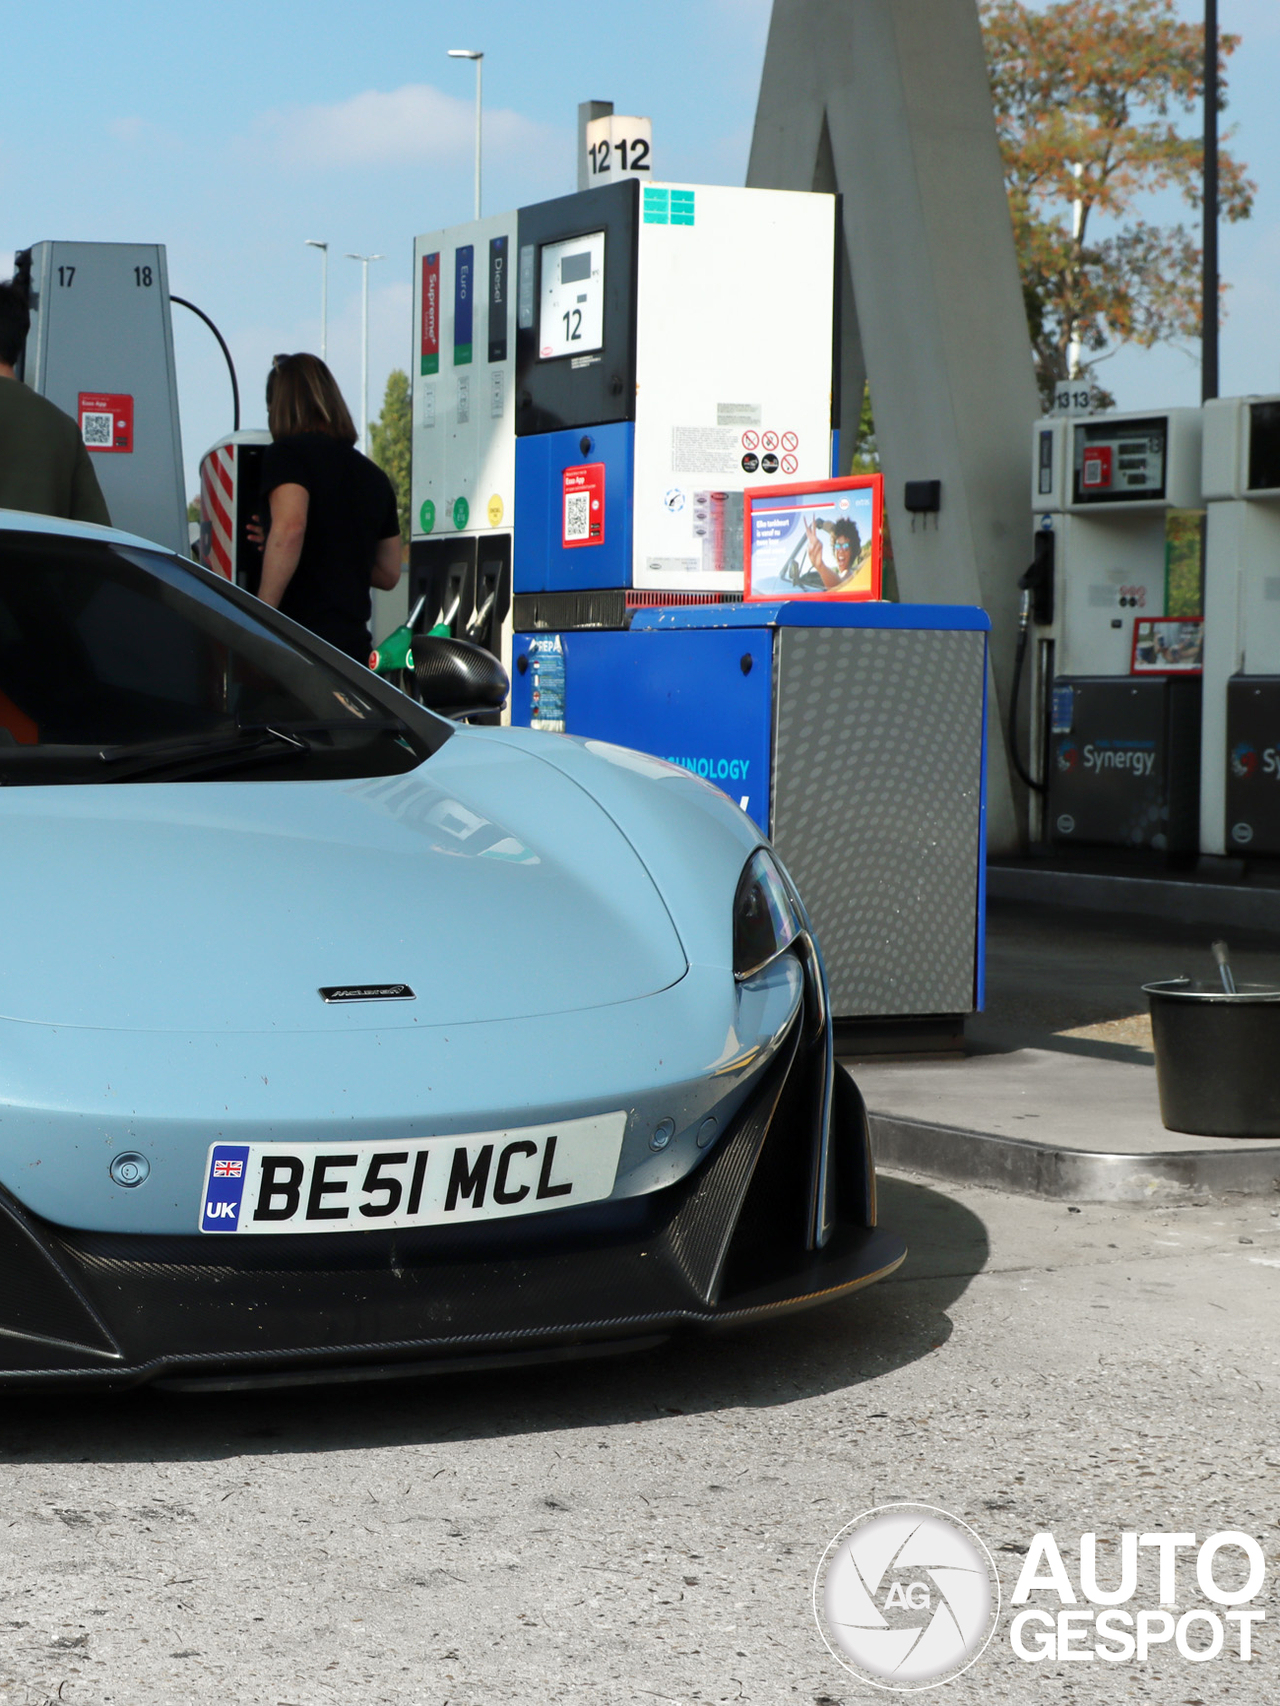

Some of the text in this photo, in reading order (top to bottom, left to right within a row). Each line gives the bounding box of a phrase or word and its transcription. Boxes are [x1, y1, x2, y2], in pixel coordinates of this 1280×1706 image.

[589, 140, 610, 174] 12
[614, 138, 650, 171] 12
[58, 266, 76, 287] 17
[134, 266, 153, 287] 18
[460, 265, 469, 300] Euro
[494, 257, 503, 303] Diesel
[562, 308, 582, 342] 12
[1072, 391, 1090, 408] 13
[1083, 744, 1155, 776] Synergy
[444, 1136, 573, 1211] MCL
[206, 1202, 236, 1219] UK
